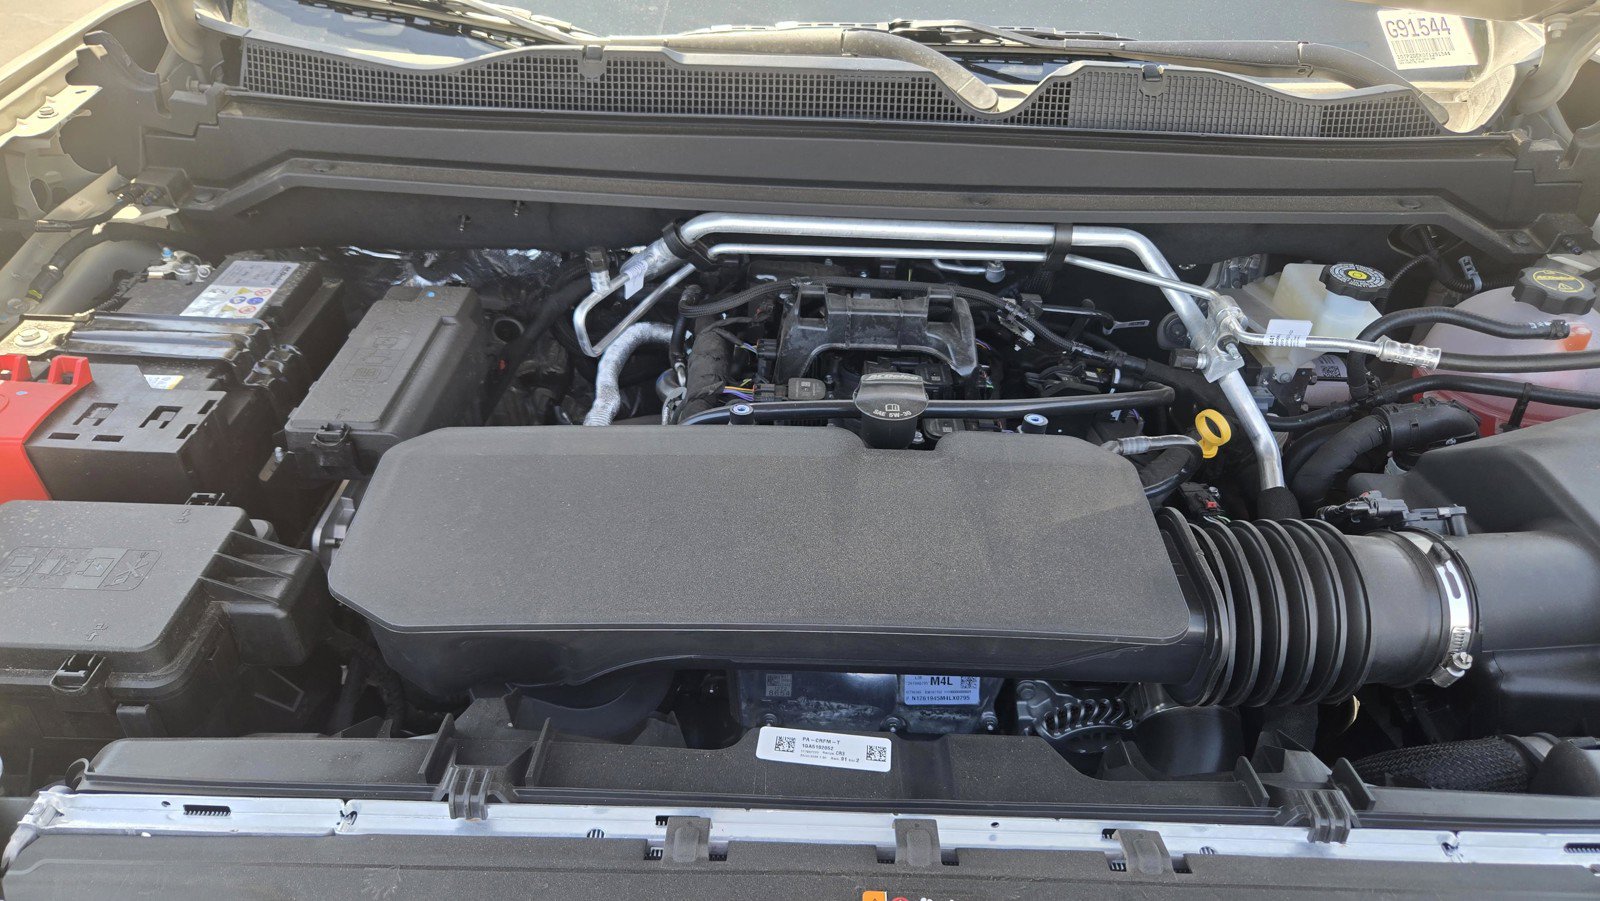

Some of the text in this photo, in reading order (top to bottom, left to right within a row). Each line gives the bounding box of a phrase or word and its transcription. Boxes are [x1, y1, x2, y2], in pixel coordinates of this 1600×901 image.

[1386, 17, 1451, 38] G91544
[873, 409, 886, 417] SAE
[930, 676, 953, 686] M4L
